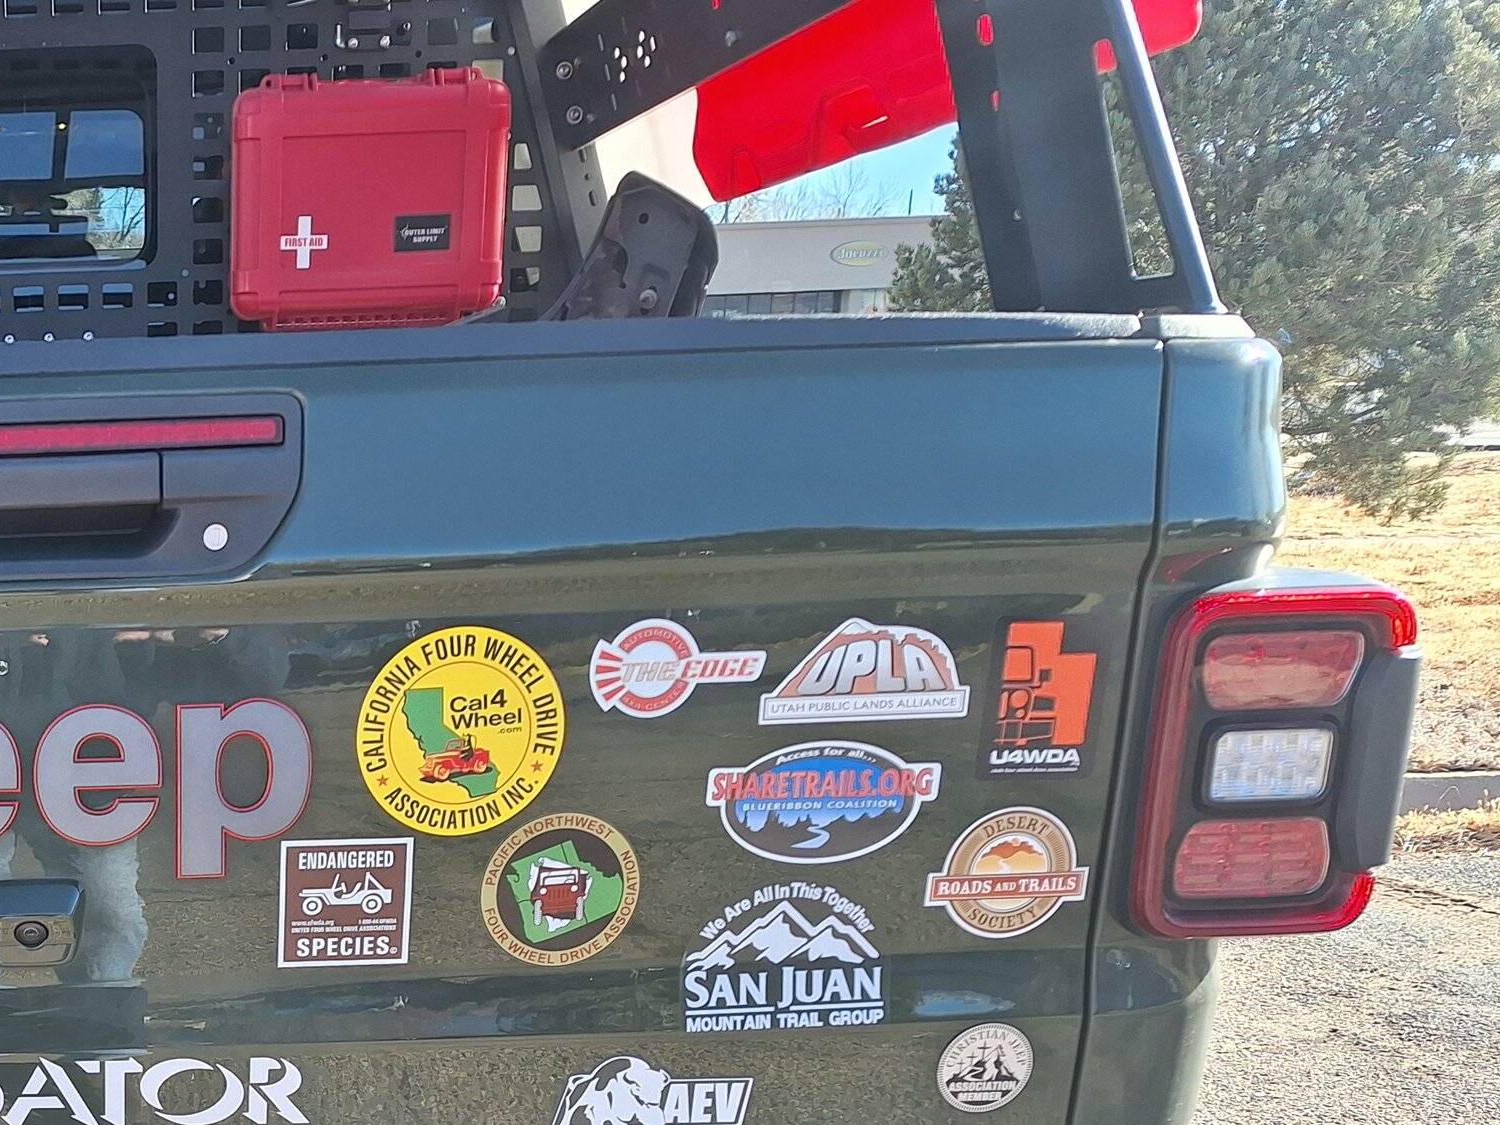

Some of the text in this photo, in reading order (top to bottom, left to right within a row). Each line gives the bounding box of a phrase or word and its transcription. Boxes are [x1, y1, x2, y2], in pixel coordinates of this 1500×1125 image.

[284, 238, 324, 246] FIRST AID
[404, 226, 445, 236] OUTER LIMIT
[412, 235, 438, 243] SUPPLY
[622, 657, 760, 682] THE EDGE
[796, 639, 946, 695] UPLA
[363, 634, 558, 773] CALIFORNIA FOUR WHEEL DRIVE
[770, 697, 957, 714] UTAH PUBLIC LANDS ALLIANCE
[451, 708, 522, 730] Wheel
[775, 748, 820, 766] Access
[822, 746, 844, 757] for
[990, 748, 1080, 766] U4WDA
[712, 768, 934, 801] SHARETRAILS.ORG
[384, 776, 539, 830] ASSOCIATION INC.
[742, 800, 897, 811] BLUERIBBON COALITION
[982, 816, 1050, 838] DESERT
[298, 850, 394, 870] ENDANGERED
[486, 816, 615, 886] PACIFIC NORTHWEST
[938, 876, 1076, 896] ROADS AND TRAILS
[484, 850, 640, 964] FOUR WHEEL DRIVE ASSOCIATION
[699, 882, 875, 940] We Are All In This Together
[968, 906, 1038, 929] SOCIETY
[296, 936, 390, 958] SPECIES
[685, 966, 883, 1009] SAN JUAN
[686, 1008, 884, 1032] MOUNTAIN TRAIL GROUP
[946, 1030, 1009, 1068] CHRISTIAN
[949, 1080, 1016, 1091] ASSOCIATION
[958, 1092, 1002, 1100] MEMBER
[664, 1082, 746, 1124] AEV
